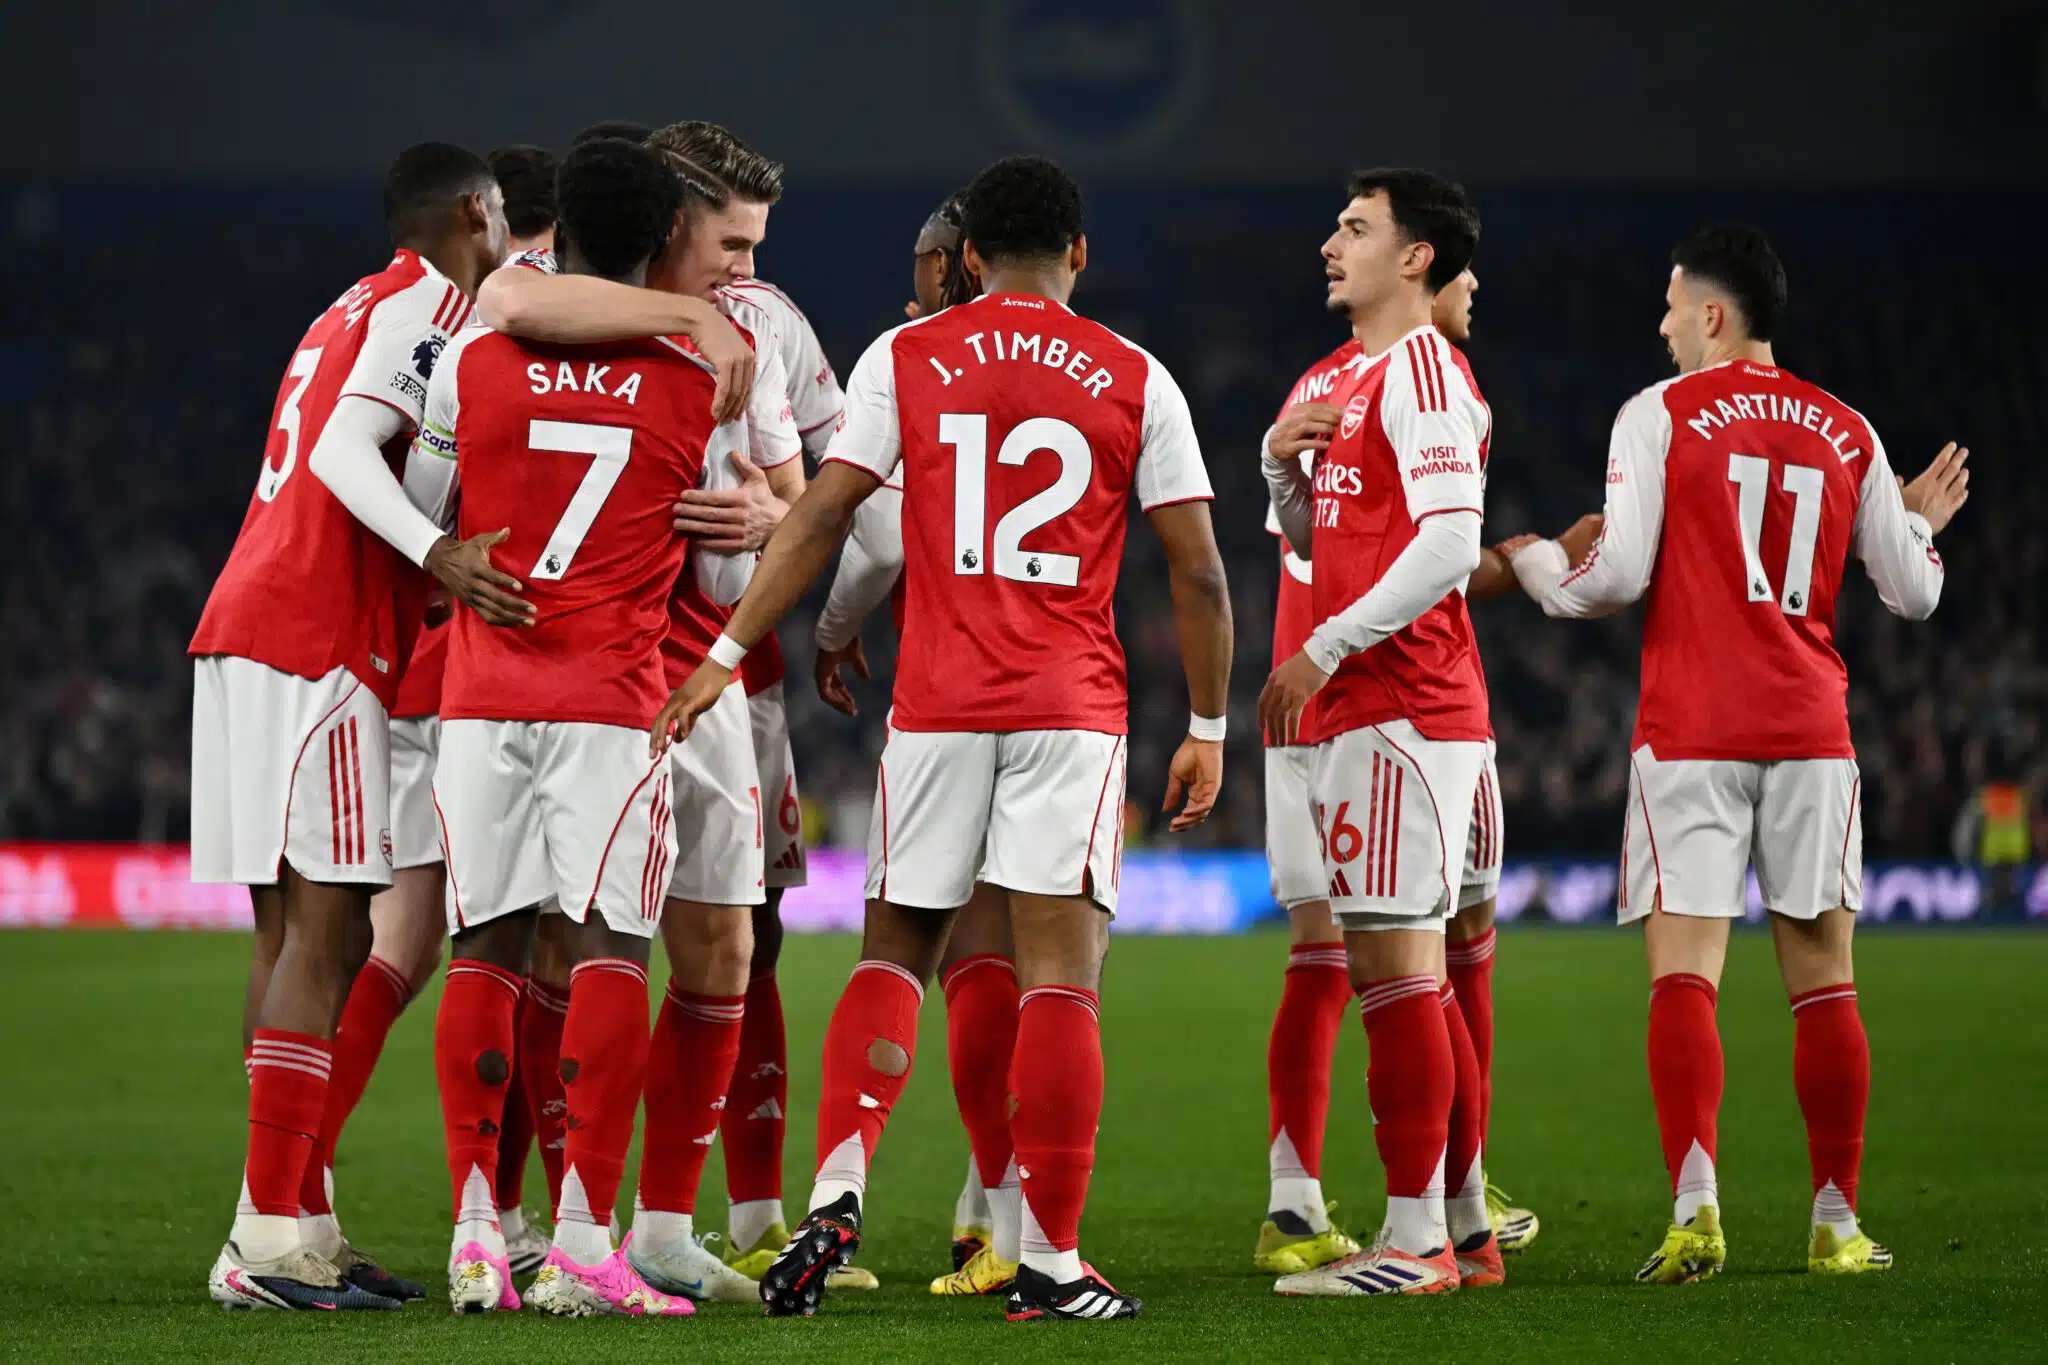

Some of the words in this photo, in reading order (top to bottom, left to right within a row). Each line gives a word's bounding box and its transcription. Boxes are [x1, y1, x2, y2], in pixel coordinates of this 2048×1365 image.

[1001, 298, 1045, 310] Arsenal
[527, 361, 642, 405] SAKA
[929, 356, 963, 386] J.
[964, 330, 1113, 399] TIMBER
[257, 345, 325, 503] 3
[422, 428, 458, 452] Capt
[1420, 446, 1457, 460] VISIT
[1687, 393, 1861, 465] MARTINELLI
[527, 419, 634, 581] 7
[938, 412, 1094, 588] 12
[1410, 460, 1474, 482] RWANDA
[1727, 452, 1825, 617] 11
[779, 774, 800, 836] 6
